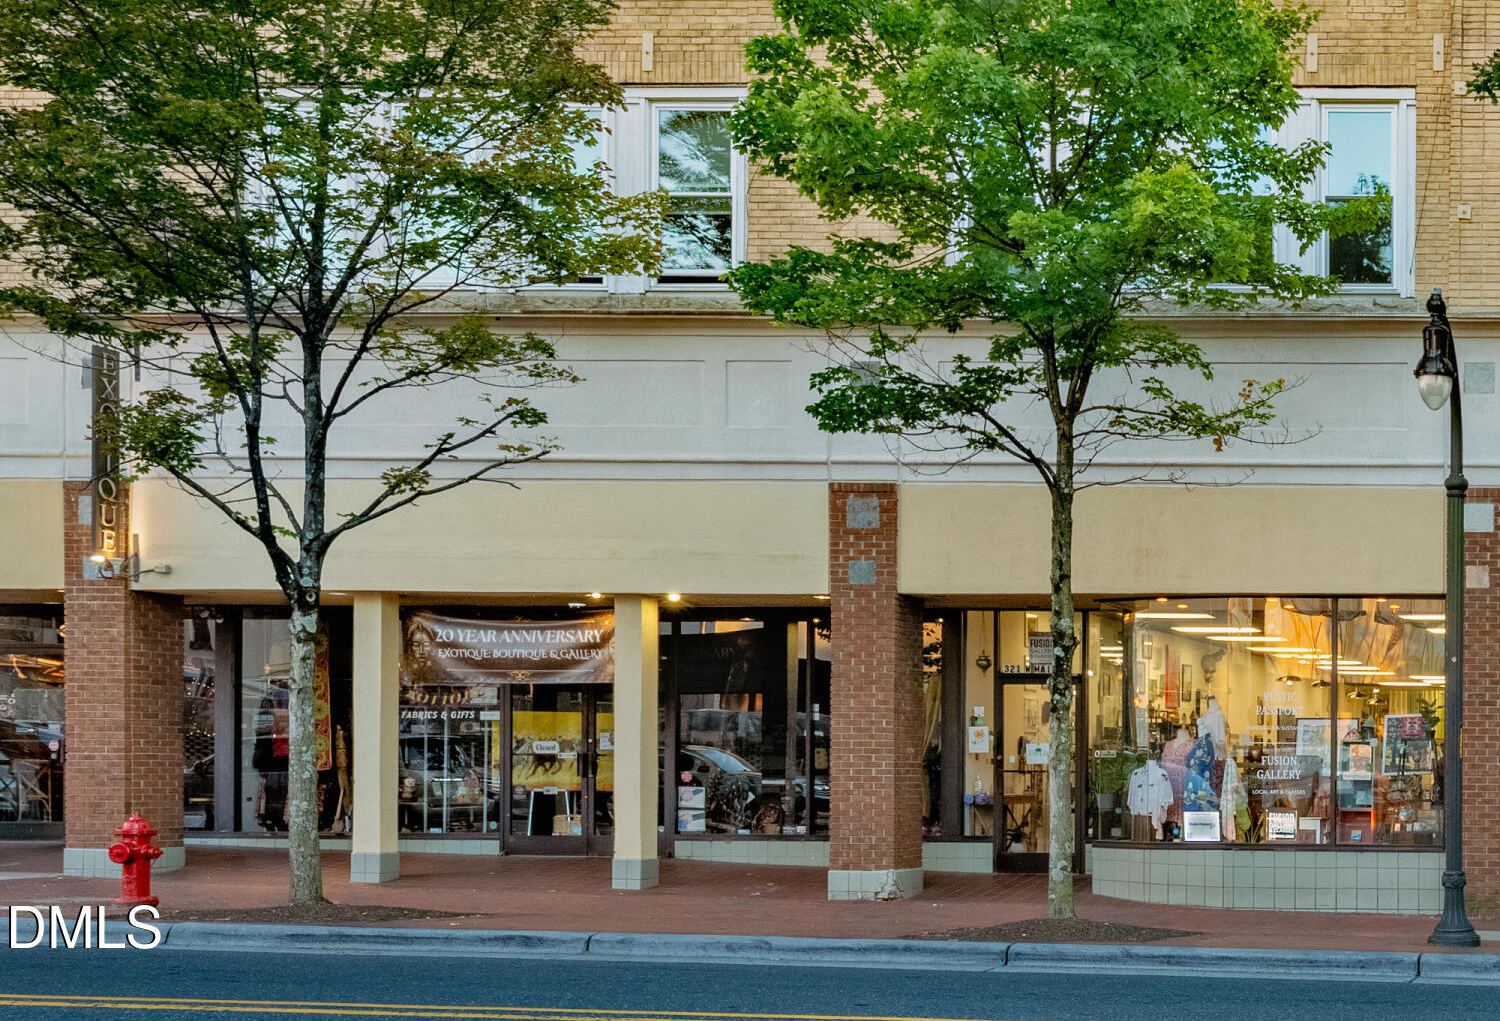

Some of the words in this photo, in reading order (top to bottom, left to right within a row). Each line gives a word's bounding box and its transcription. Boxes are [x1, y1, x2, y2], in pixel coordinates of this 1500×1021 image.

[99, 352, 118, 553] EXOIQUE
[435, 629, 454, 643] 20
[457, 629, 498, 643] YEAR
[500, 629, 603, 643] ANNIVERSARY
[493, 648, 548, 660] BOUTIQUE
[549, 649, 561, 659] &
[560, 649, 603, 660] GALLERY
[1004, 665, 1020, 673] 321
[1034, 665, 1051, 673] MAI
[401, 710, 439, 719] FABRICS
[440, 710, 448, 720] &
[450, 710, 476, 719] GIFTS
[1256, 706, 1304, 715] PASSPORT
[1261, 755, 1297, 766] FUSION
[1256, 769, 1302, 780] GALLERY
